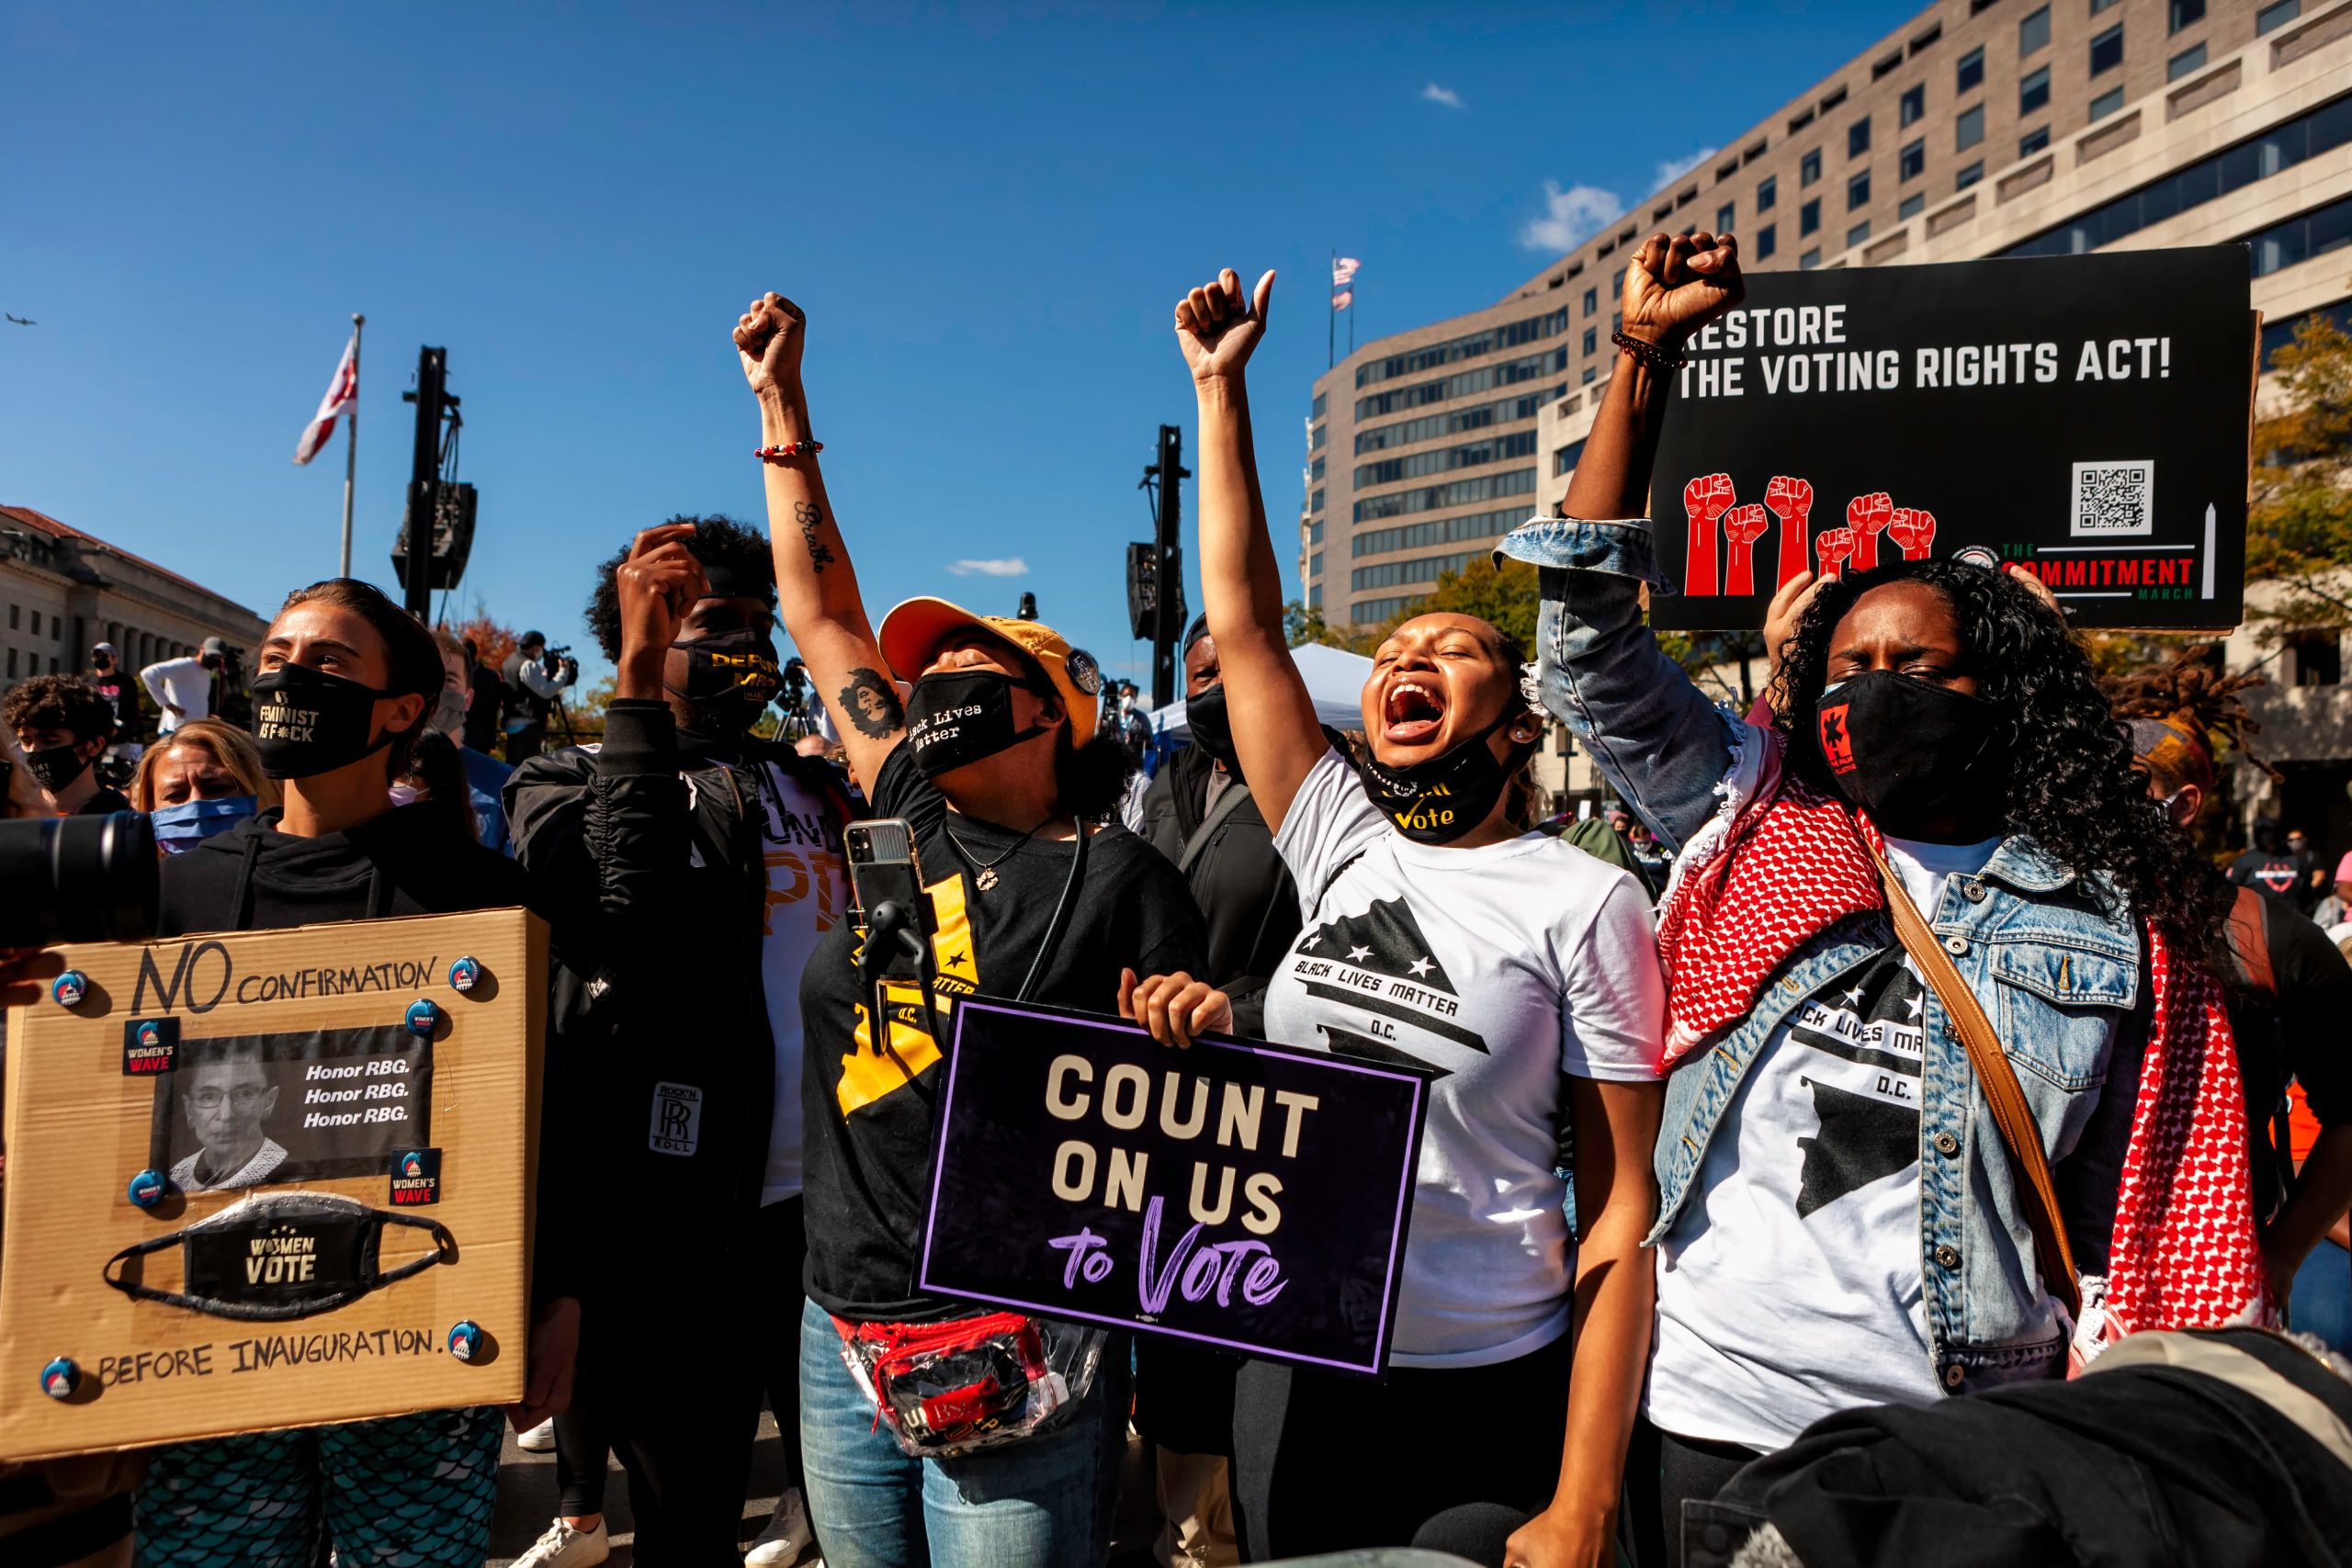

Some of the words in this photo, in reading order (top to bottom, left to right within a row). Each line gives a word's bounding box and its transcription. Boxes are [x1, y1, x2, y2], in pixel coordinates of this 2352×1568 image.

[1681, 357, 1744, 398] THE
[1760, 349, 1899, 395] VOTING
[1916, 342, 2058, 388] RIGHTS
[2075, 336, 2171, 382] ACT!
[2002, 543, 2034, 557] THE
[2138, 588, 2194, 600] MARCH
[711, 652, 778, 673] DEFUN
[260, 705, 320, 727] FEMINIST
[933, 705, 982, 726] Lives
[259, 723, 268, 739] AS
[1394, 800, 1454, 829] Vote
[130, 940, 233, 1016] NO
[236, 956, 438, 1005] CONFIRMATION
[933, 976, 976, 995] ATTER
[1294, 960, 1333, 978] BLACK
[1337, 968, 1383, 991] LIVES
[1388, 982, 1459, 1017] MATTER
[1371, 1019, 1396, 1041] D.C.
[1835, 1015, 1883, 1043] LIVES
[128, 1045, 174, 1059] WOMEN'S
[130, 1056, 170, 1073] WAVE
[305, 1065, 364, 1081] Honor
[365, 1058, 410, 1077] RBG.
[304, 1089, 362, 1104] Honor
[364, 1082, 409, 1100] RBG.
[1876, 1075, 1912, 1100] D.C.
[303, 1111, 362, 1128] Honor
[363, 1106, 409, 1123] RBG.
[1045, 1054, 1319, 1158] COUNT
[653, 1139, 690, 1152] ROLL
[392, 1177, 435, 1190] WOMEN'S
[1051, 1139, 1148, 1213] ON
[1188, 1161, 1283, 1235] US
[393, 1188, 432, 1203] WAVE
[250, 1236, 315, 1256] WOMEN
[1047, 1225, 1114, 1289] to
[1138, 1195, 1289, 1314] Vote
[245, 1254, 317, 1284] VOTE
[98, 1343, 213, 1388] BEFORE
[229, 1328, 444, 1374] INAUGURATION.
